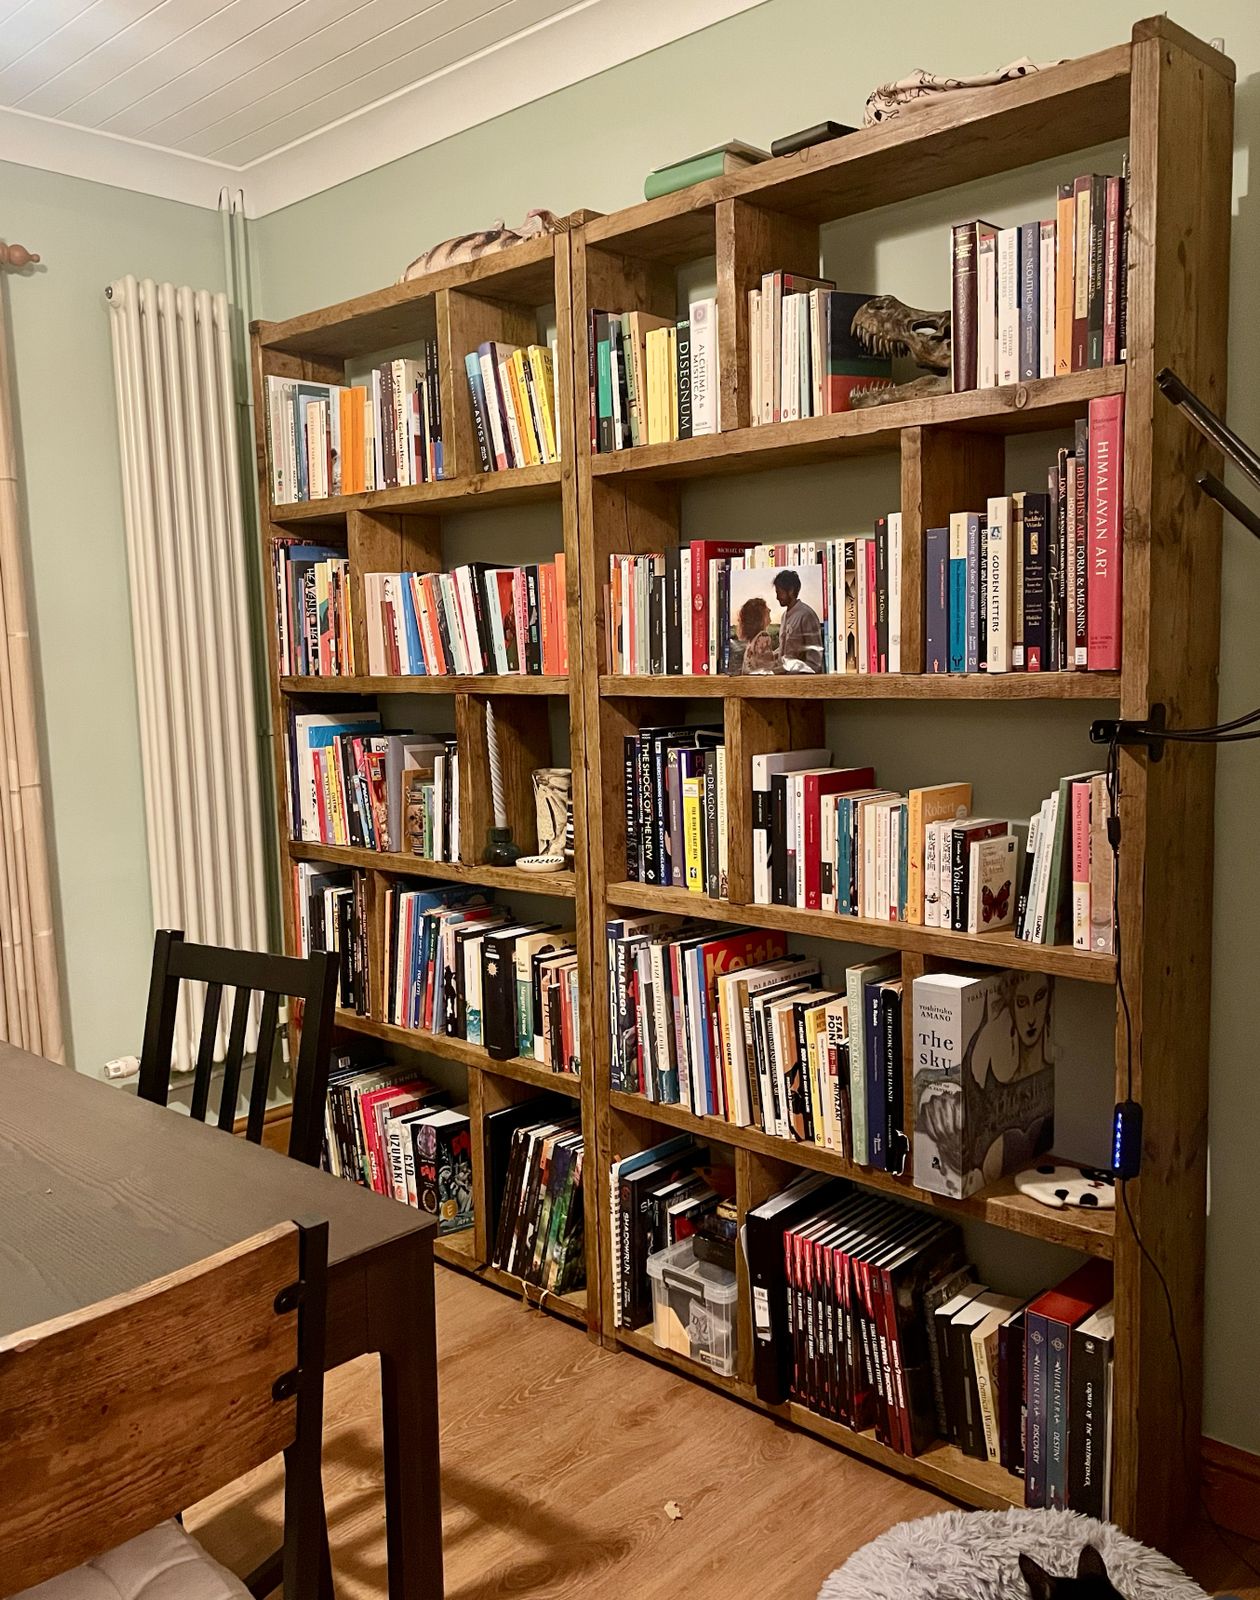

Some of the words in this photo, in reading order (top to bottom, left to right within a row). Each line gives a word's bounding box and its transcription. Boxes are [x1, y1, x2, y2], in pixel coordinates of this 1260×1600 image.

[1025, 258, 1033, 303] NEOLITHIC
[679, 341, 690, 429] DISEGNUM
[474, 410, 484, 442] ABYSS
[1059, 477, 1067, 499] LOKA
[1075, 466, 1085, 522] BUDDHIST
[1096, 441, 1109, 540] HIMALAYAN
[1068, 516, 1074, 527] TO
[1076, 523, 1085, 543] ART
[1076, 545, 1085, 575] FORM
[1095, 547, 1108, 578] ART
[1076, 588, 1086, 636] MEANING
[642, 743, 650, 762] THE
[642, 763, 651, 798] SHOCK
[643, 800, 651, 813] OF
[707, 777, 715, 820] DRAGON
[644, 816, 652, 833] THE
[645, 836, 653, 860] NEW
[953, 865, 964, 895] Yokai
[617, 945, 626, 983] PAULA
[706, 938, 785, 977] Keith
[849, 976, 859, 1012] CHINESE
[920, 1011, 951, 1022] AMANO
[887, 1048, 893, 1060] OF
[920, 1050, 952, 1076] sky
[833, 1083, 841, 1122] MIYAZAKI
[390, 1134, 403, 1184] UZUMAKI
[404, 1154, 414, 1176] GYO
[875, 1369, 883, 1396] EVERYTHING
[978, 1376, 991, 1413] Chemical
[984, 1414, 994, 1446] Warrior
[1086, 1410, 1092, 1419] OF
